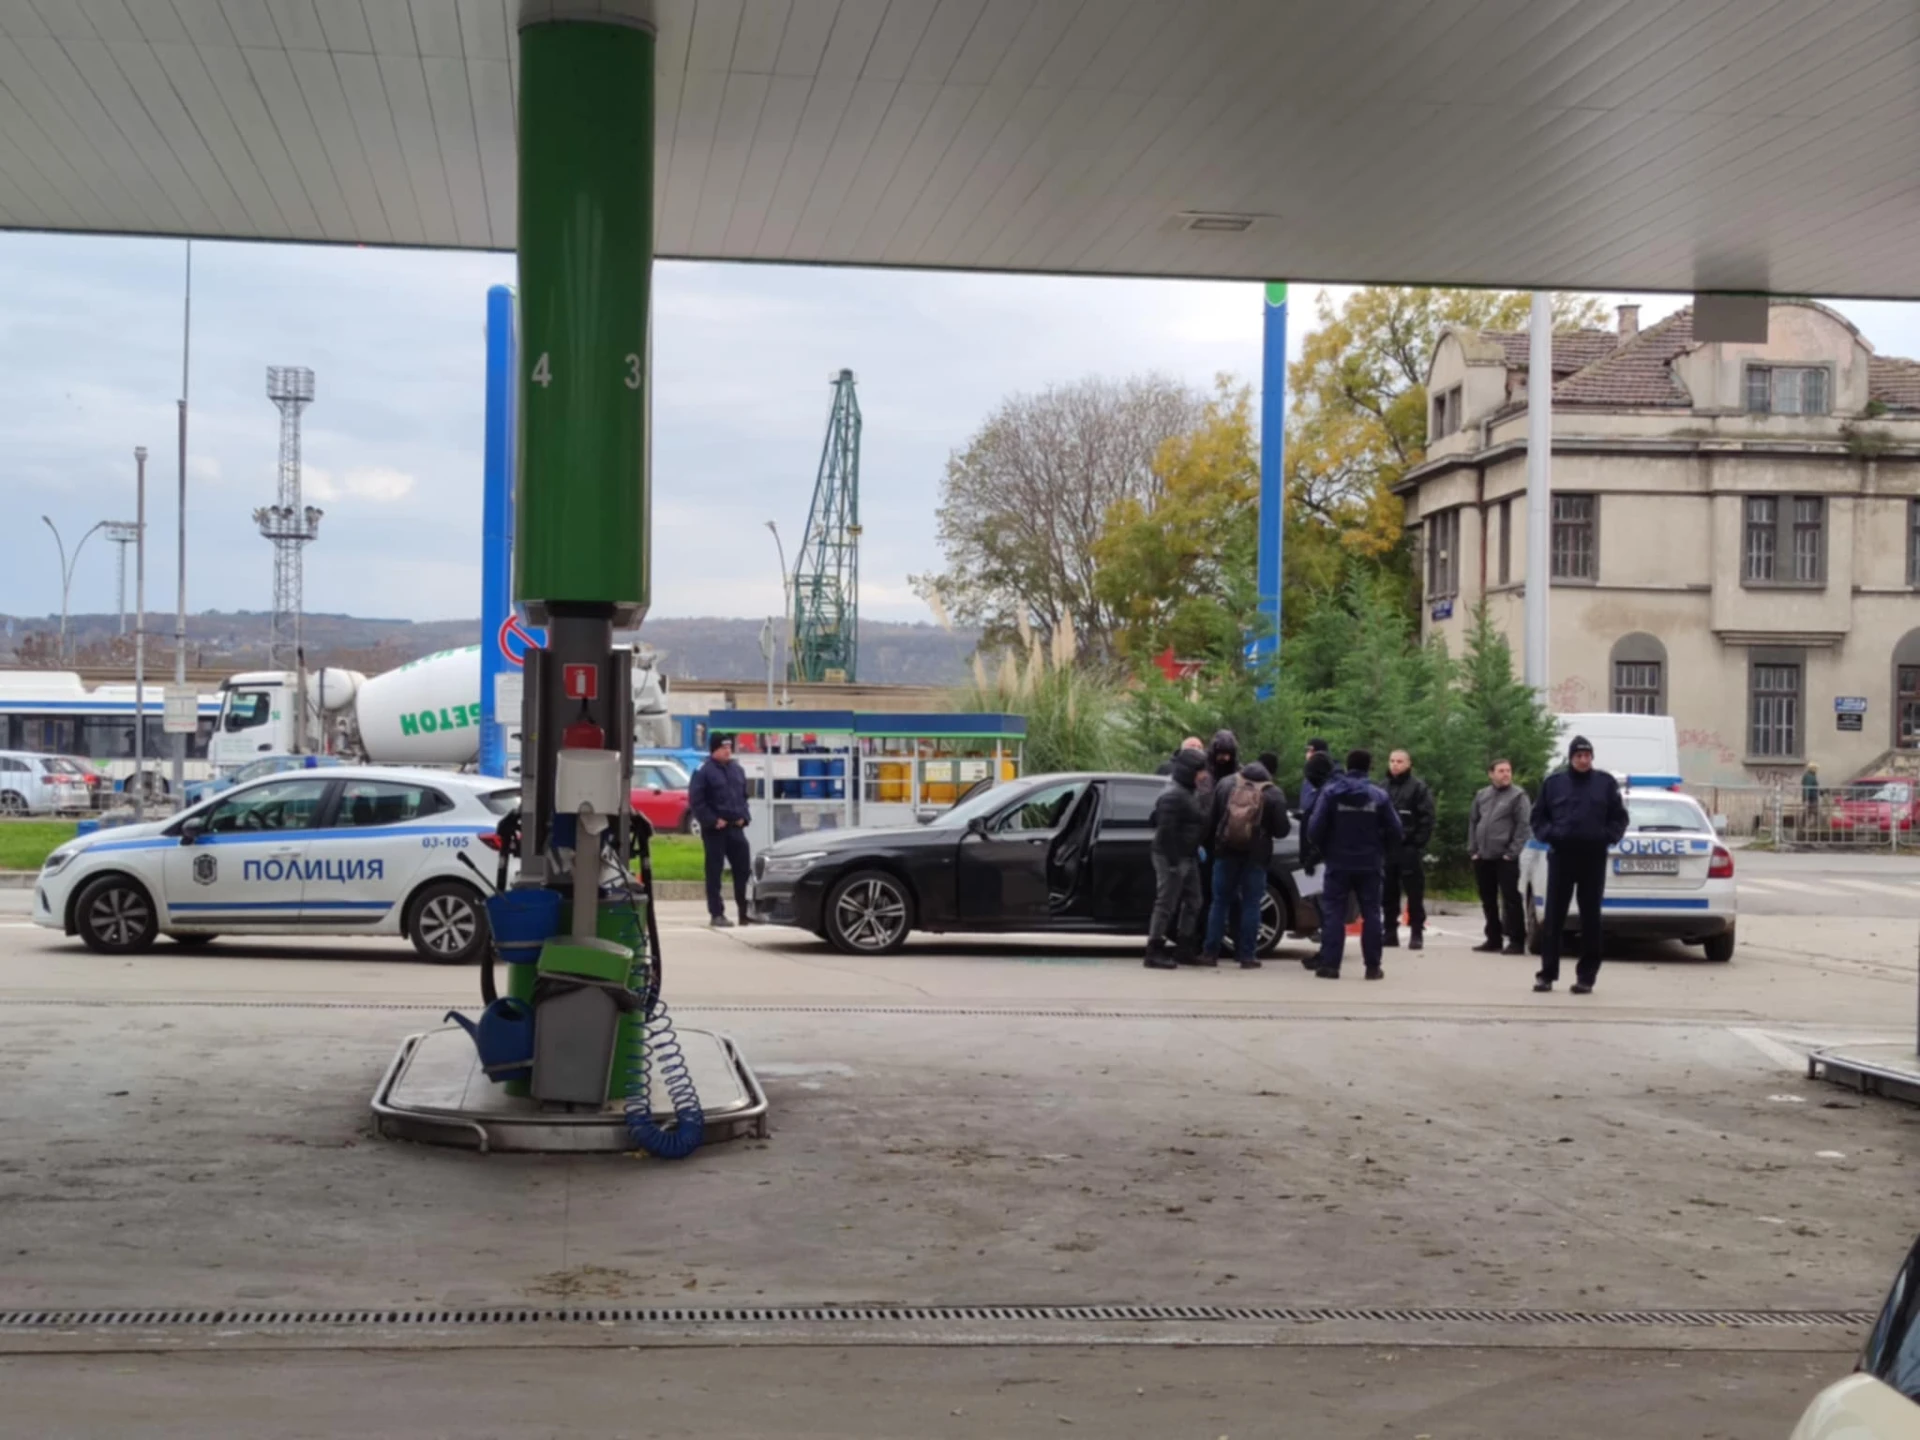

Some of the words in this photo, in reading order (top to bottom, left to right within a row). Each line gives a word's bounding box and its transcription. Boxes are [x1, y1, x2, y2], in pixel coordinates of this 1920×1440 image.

[531, 351, 553, 389] 4
[623, 352, 642, 390] 3
[422, 836, 469, 848] 03-105
[243, 859, 384, 884] ПОЛИЦИЯ
